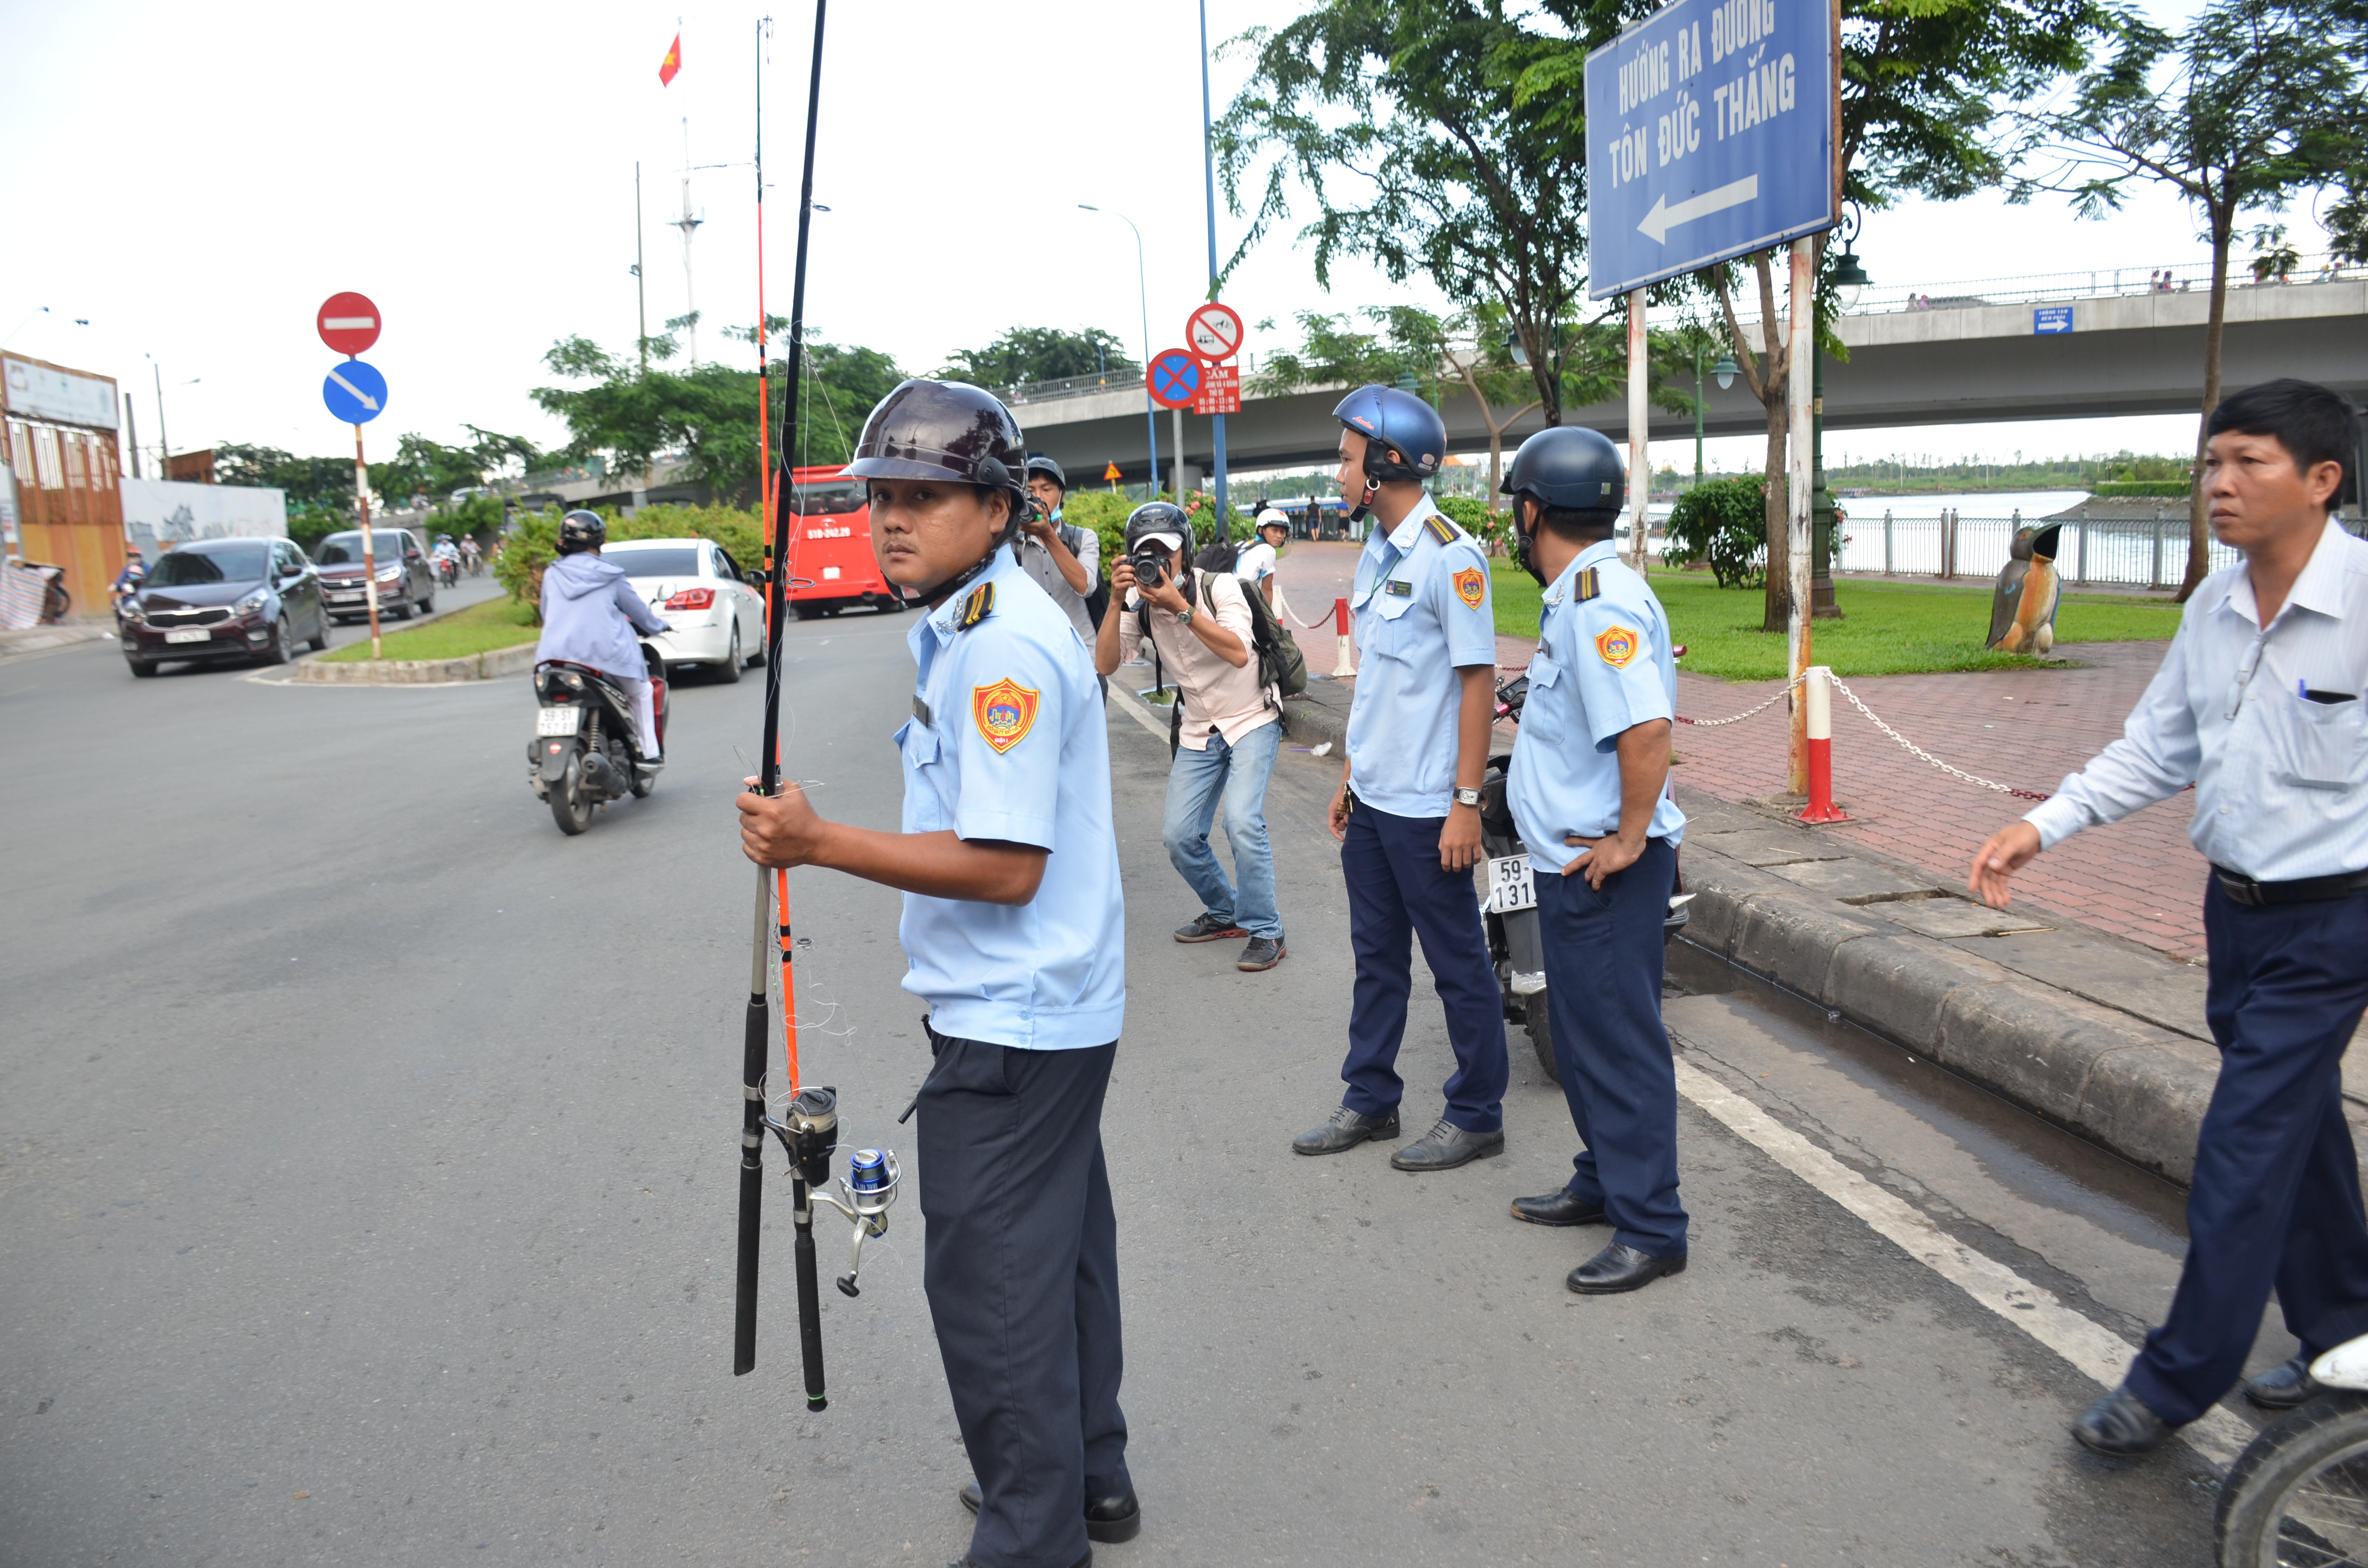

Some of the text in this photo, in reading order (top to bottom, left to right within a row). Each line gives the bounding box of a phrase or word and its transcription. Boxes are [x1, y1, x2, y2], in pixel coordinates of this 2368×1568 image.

[1609, 42, 1795, 189] TÔN ĐỨC THẮNG
[1619, 39, 1669, 116] HƯỚNG
[1678, 20, 1702, 83] RA
